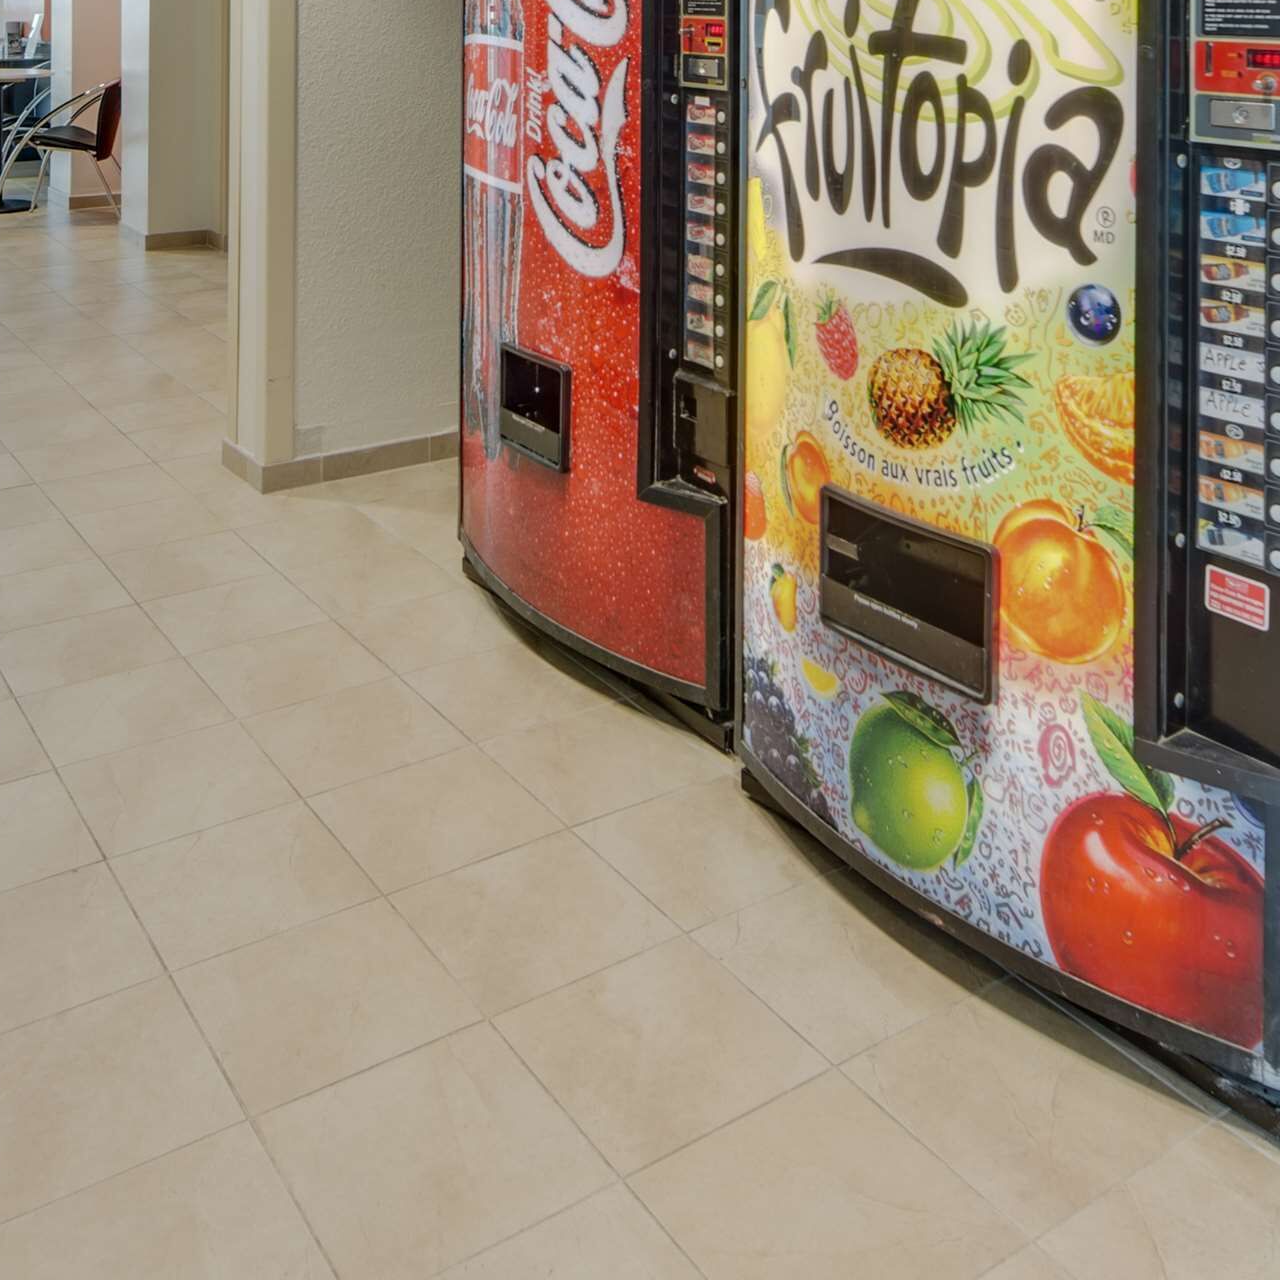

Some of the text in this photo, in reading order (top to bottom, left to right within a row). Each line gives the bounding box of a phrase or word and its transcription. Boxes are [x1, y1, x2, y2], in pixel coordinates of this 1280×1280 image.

[1093, 230, 1116, 245] MD
[826, 399, 1014, 489] Boisson aux vrais fruits
